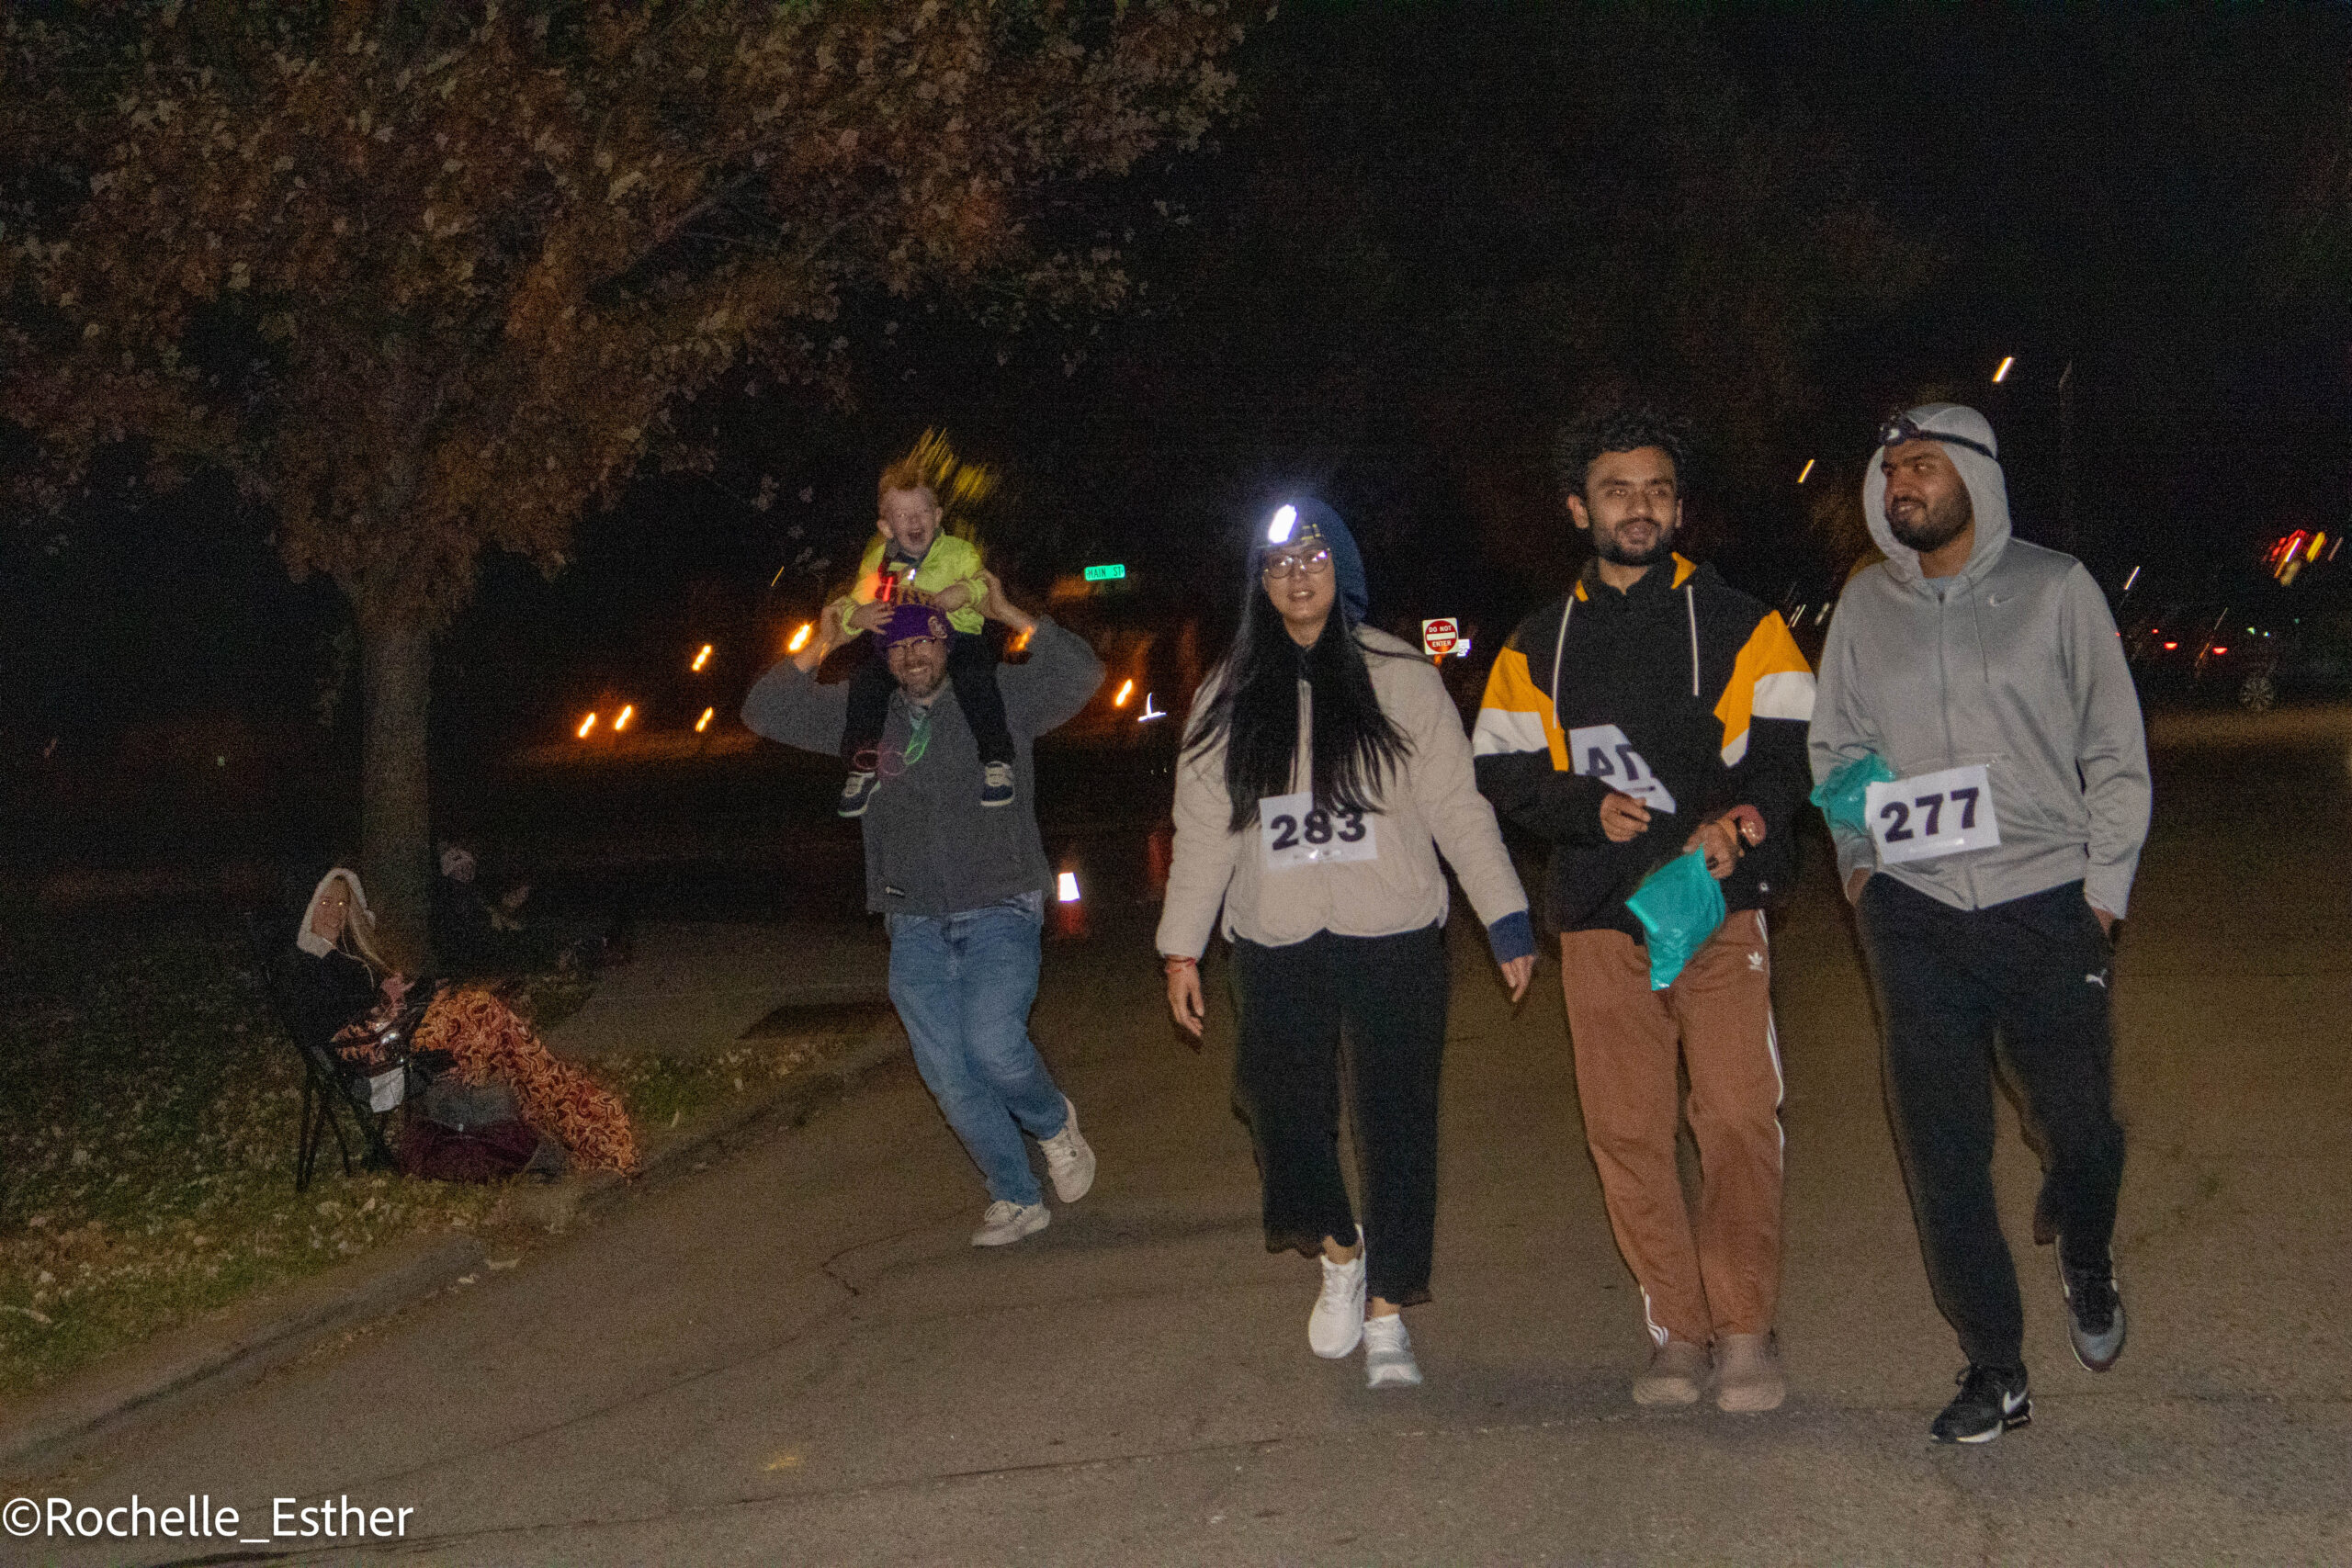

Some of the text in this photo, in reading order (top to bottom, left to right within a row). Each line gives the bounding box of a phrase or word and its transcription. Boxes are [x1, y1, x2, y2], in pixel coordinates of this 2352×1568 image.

[1088, 566, 1122, 578] MAIN ST
[1270, 808, 1366, 851] 283
[1880, 787, 1980, 843] 277
